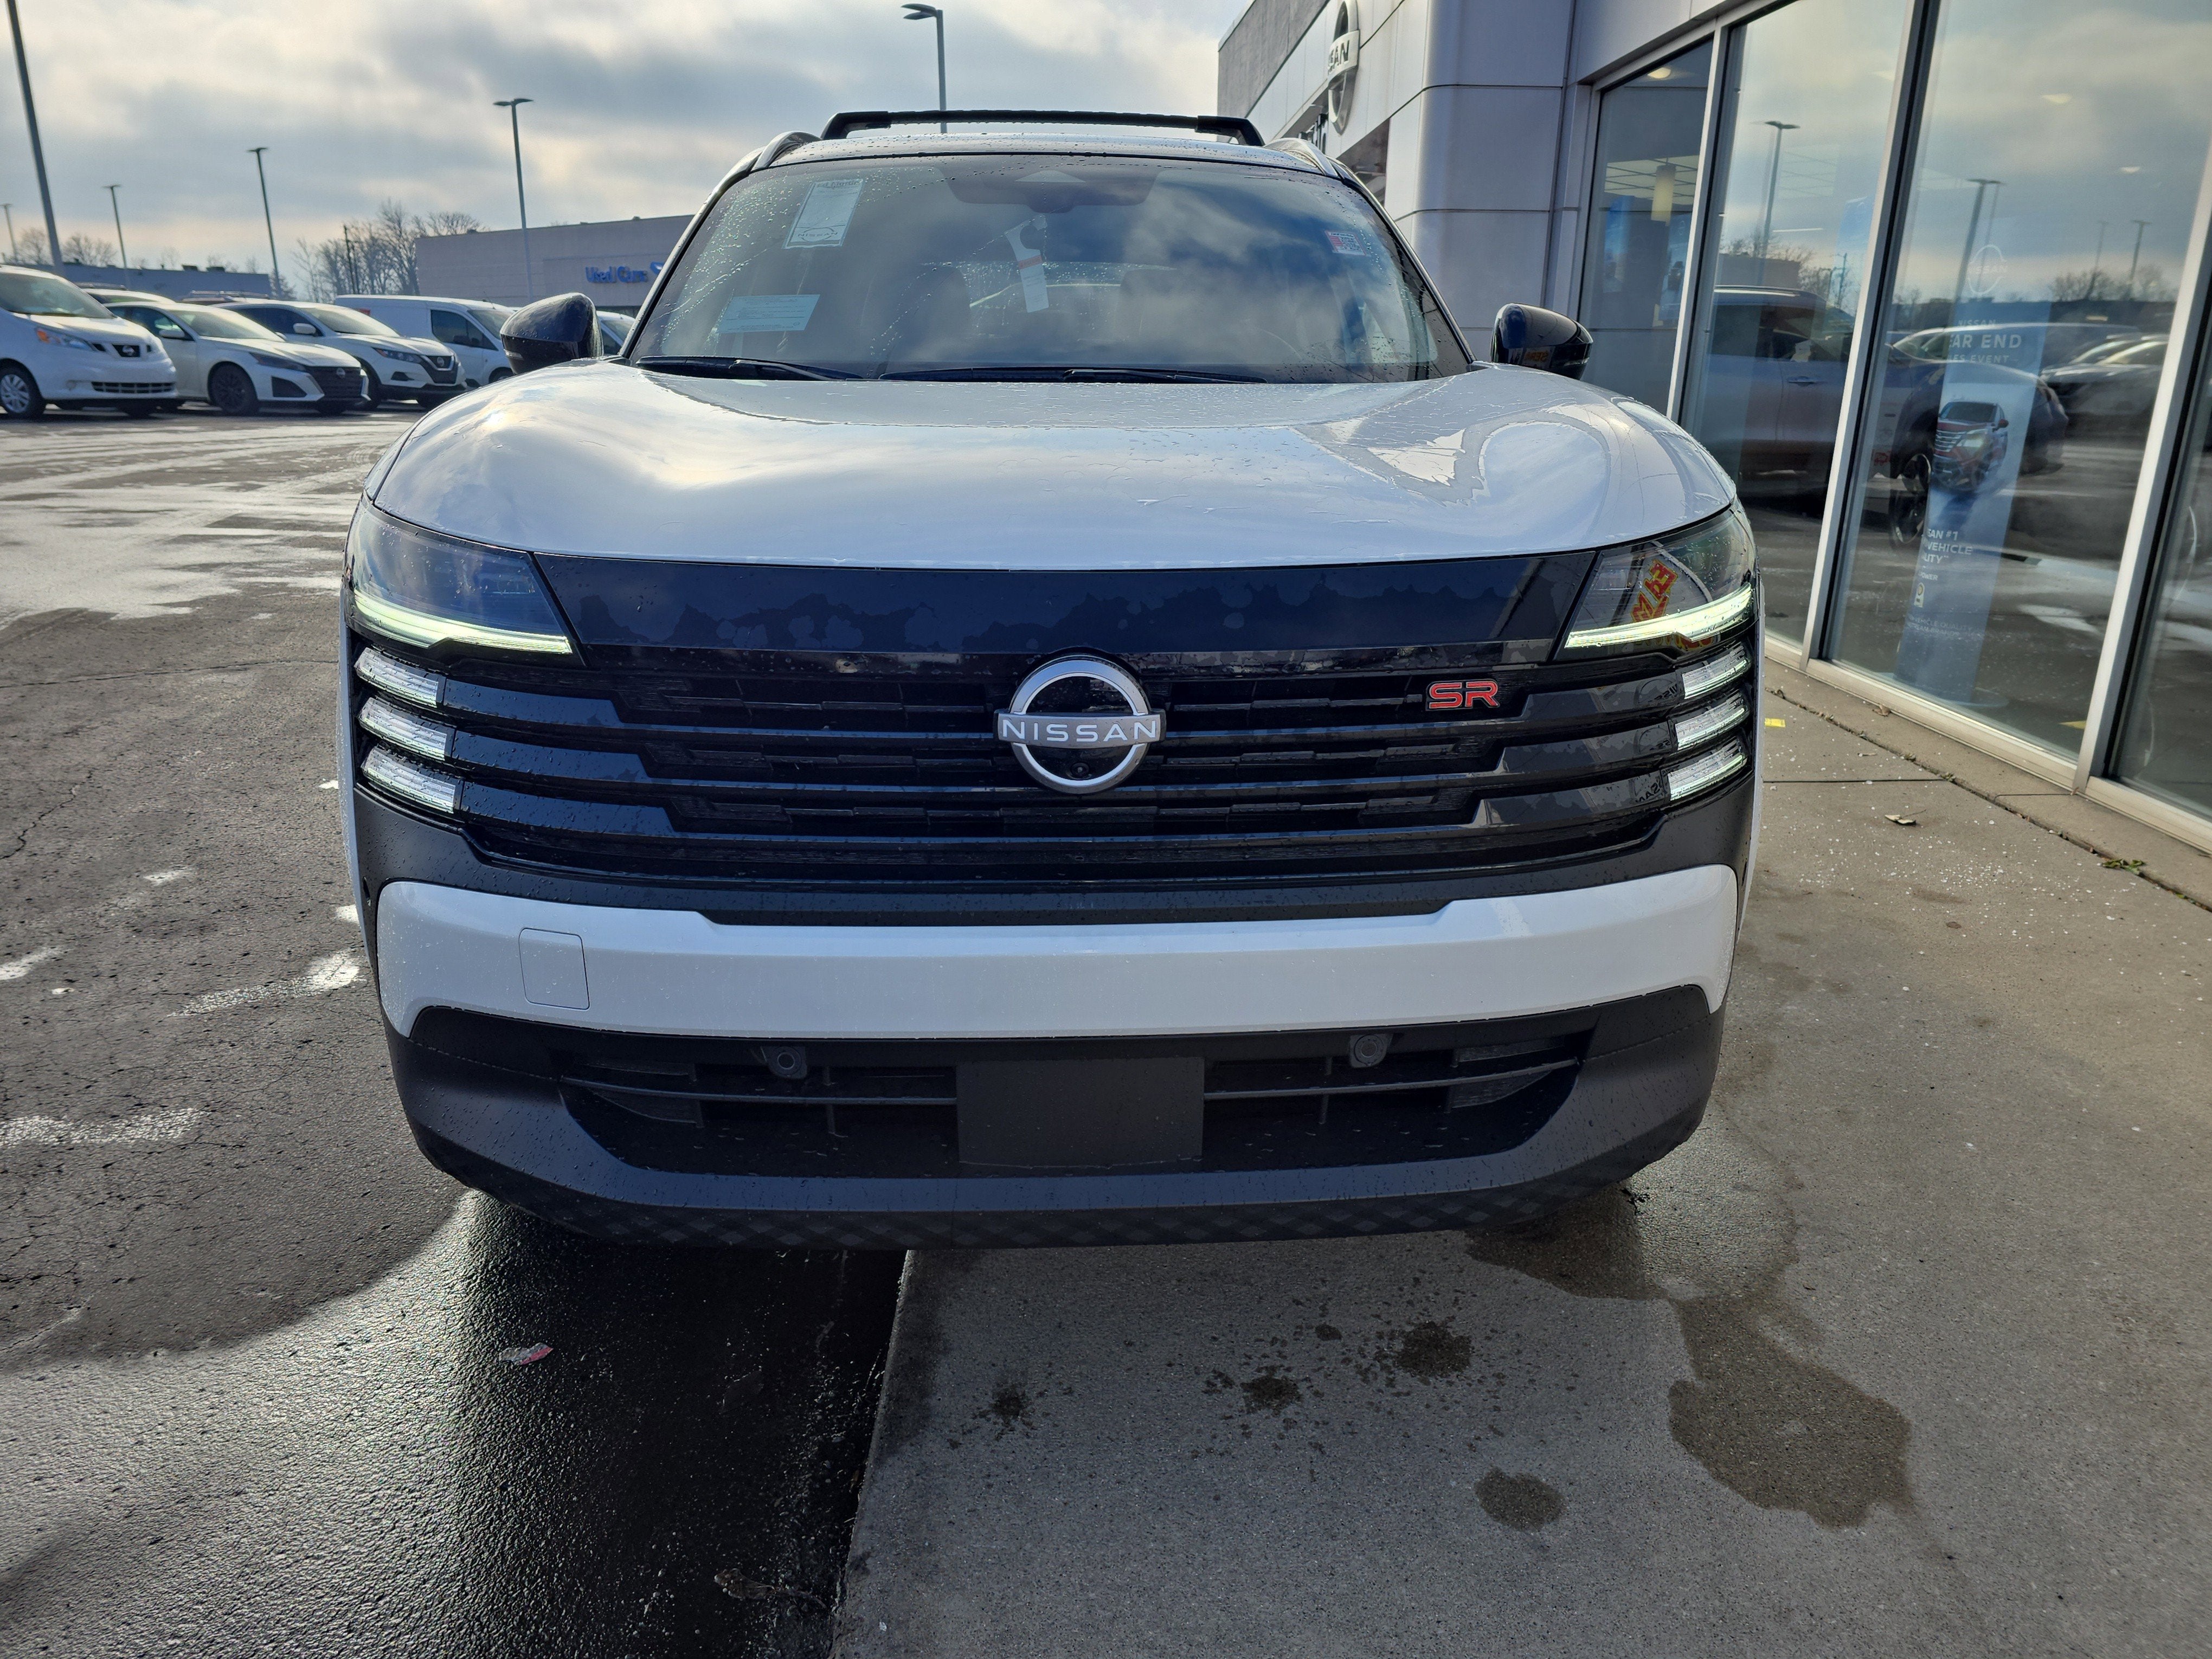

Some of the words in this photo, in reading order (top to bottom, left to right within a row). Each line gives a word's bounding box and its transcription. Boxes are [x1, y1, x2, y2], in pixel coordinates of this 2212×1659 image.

[585, 266, 615, 282] Used
[617, 266, 648, 283] Cars
[1980, 335, 2022, 348] END
[1970, 355, 2010, 364] EVENT
[1946, 529, 1958, 541] #1
[1927, 541, 1972, 555] VEHICLE
[1429, 681, 1498, 709] SR
[1002, 719, 1156, 742] NISSAN
